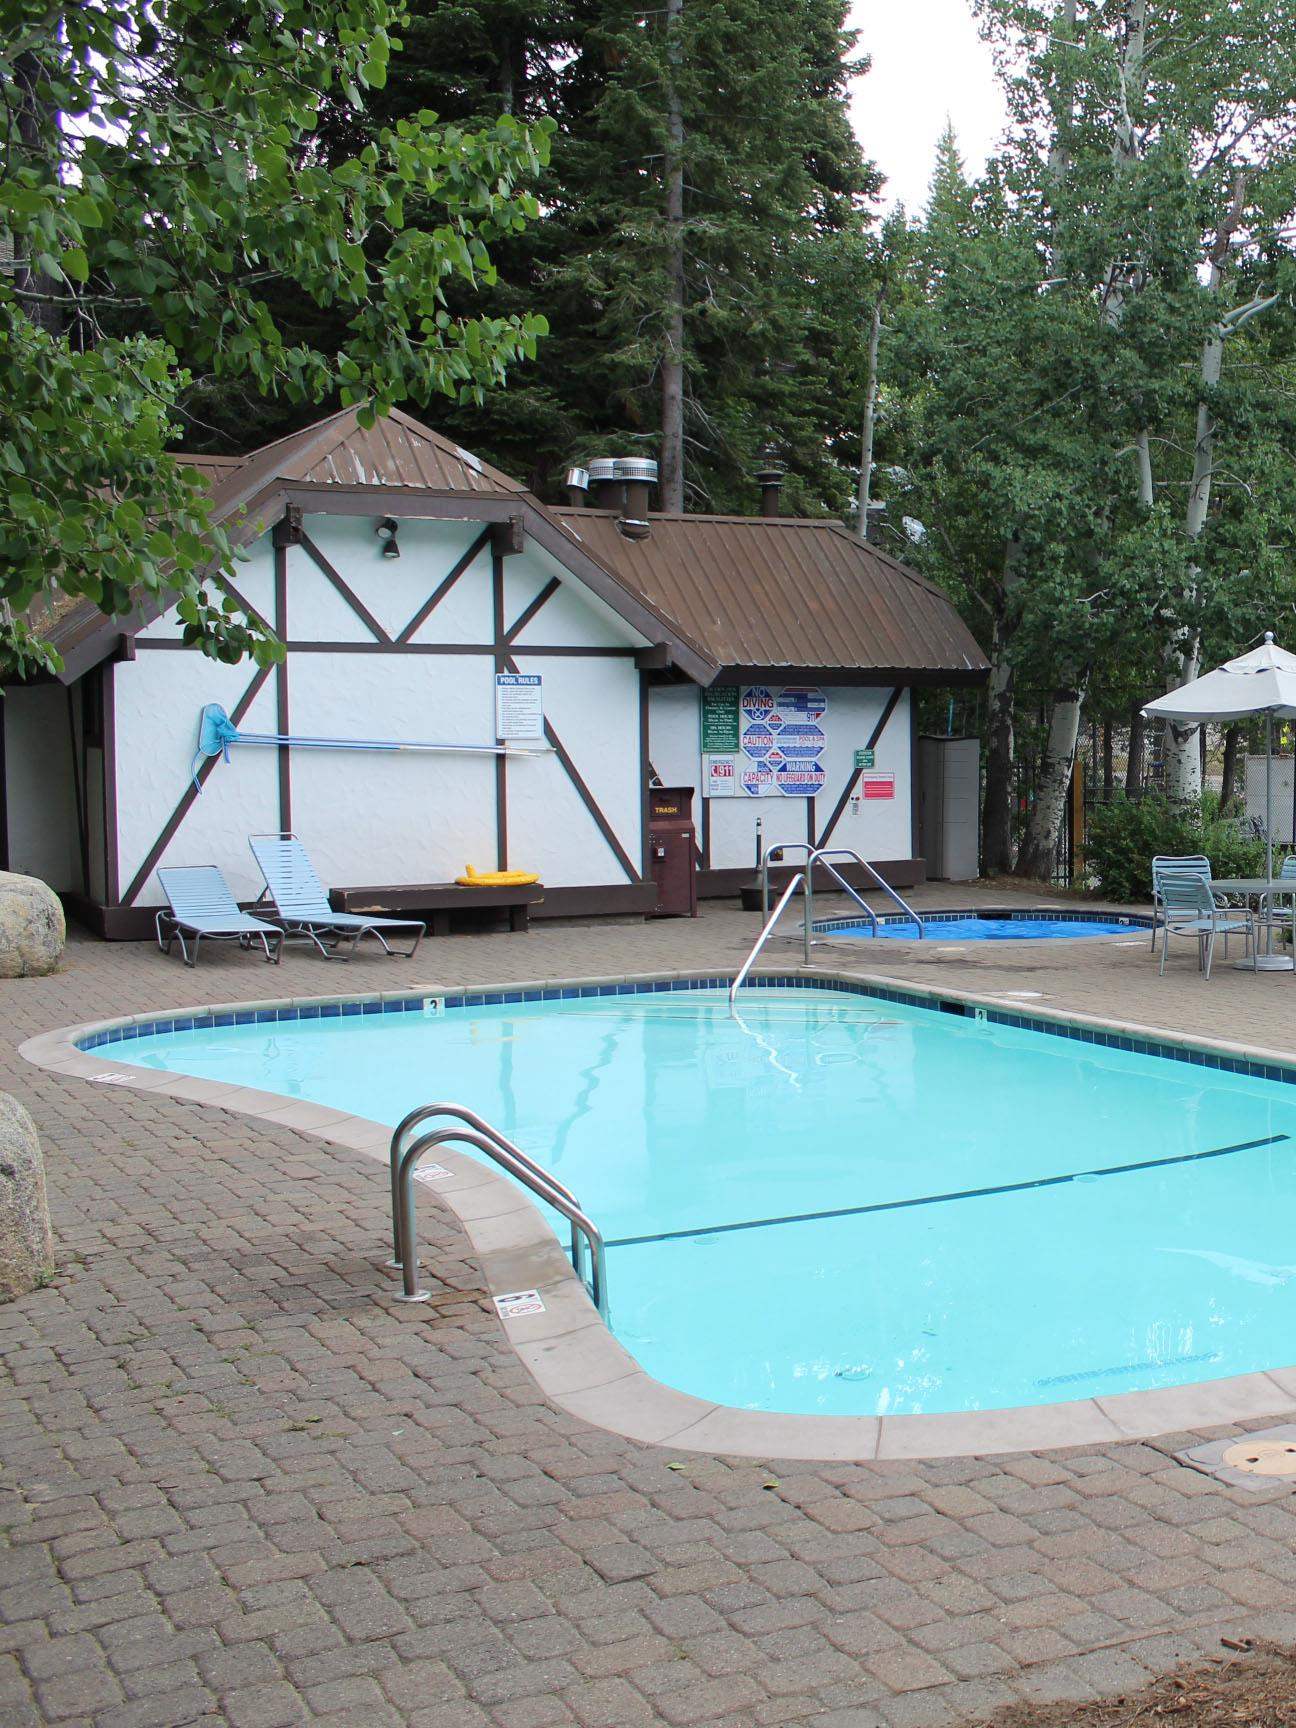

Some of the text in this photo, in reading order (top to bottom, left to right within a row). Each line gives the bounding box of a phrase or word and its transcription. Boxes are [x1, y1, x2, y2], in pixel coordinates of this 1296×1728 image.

[752, 687, 765, 697] NO
[743, 698, 774, 708] DIVING
[807, 712, 816, 722] 911
[742, 736, 773, 745] CAUTION
[720, 766, 733, 776] 911
[787, 761, 816, 771] WARNING
[743, 772, 773, 783] CAPACITY
[776, 773, 825, 782] NO LIFEGUARD ON DUTY
[655, 806, 678, 814] TRASH
